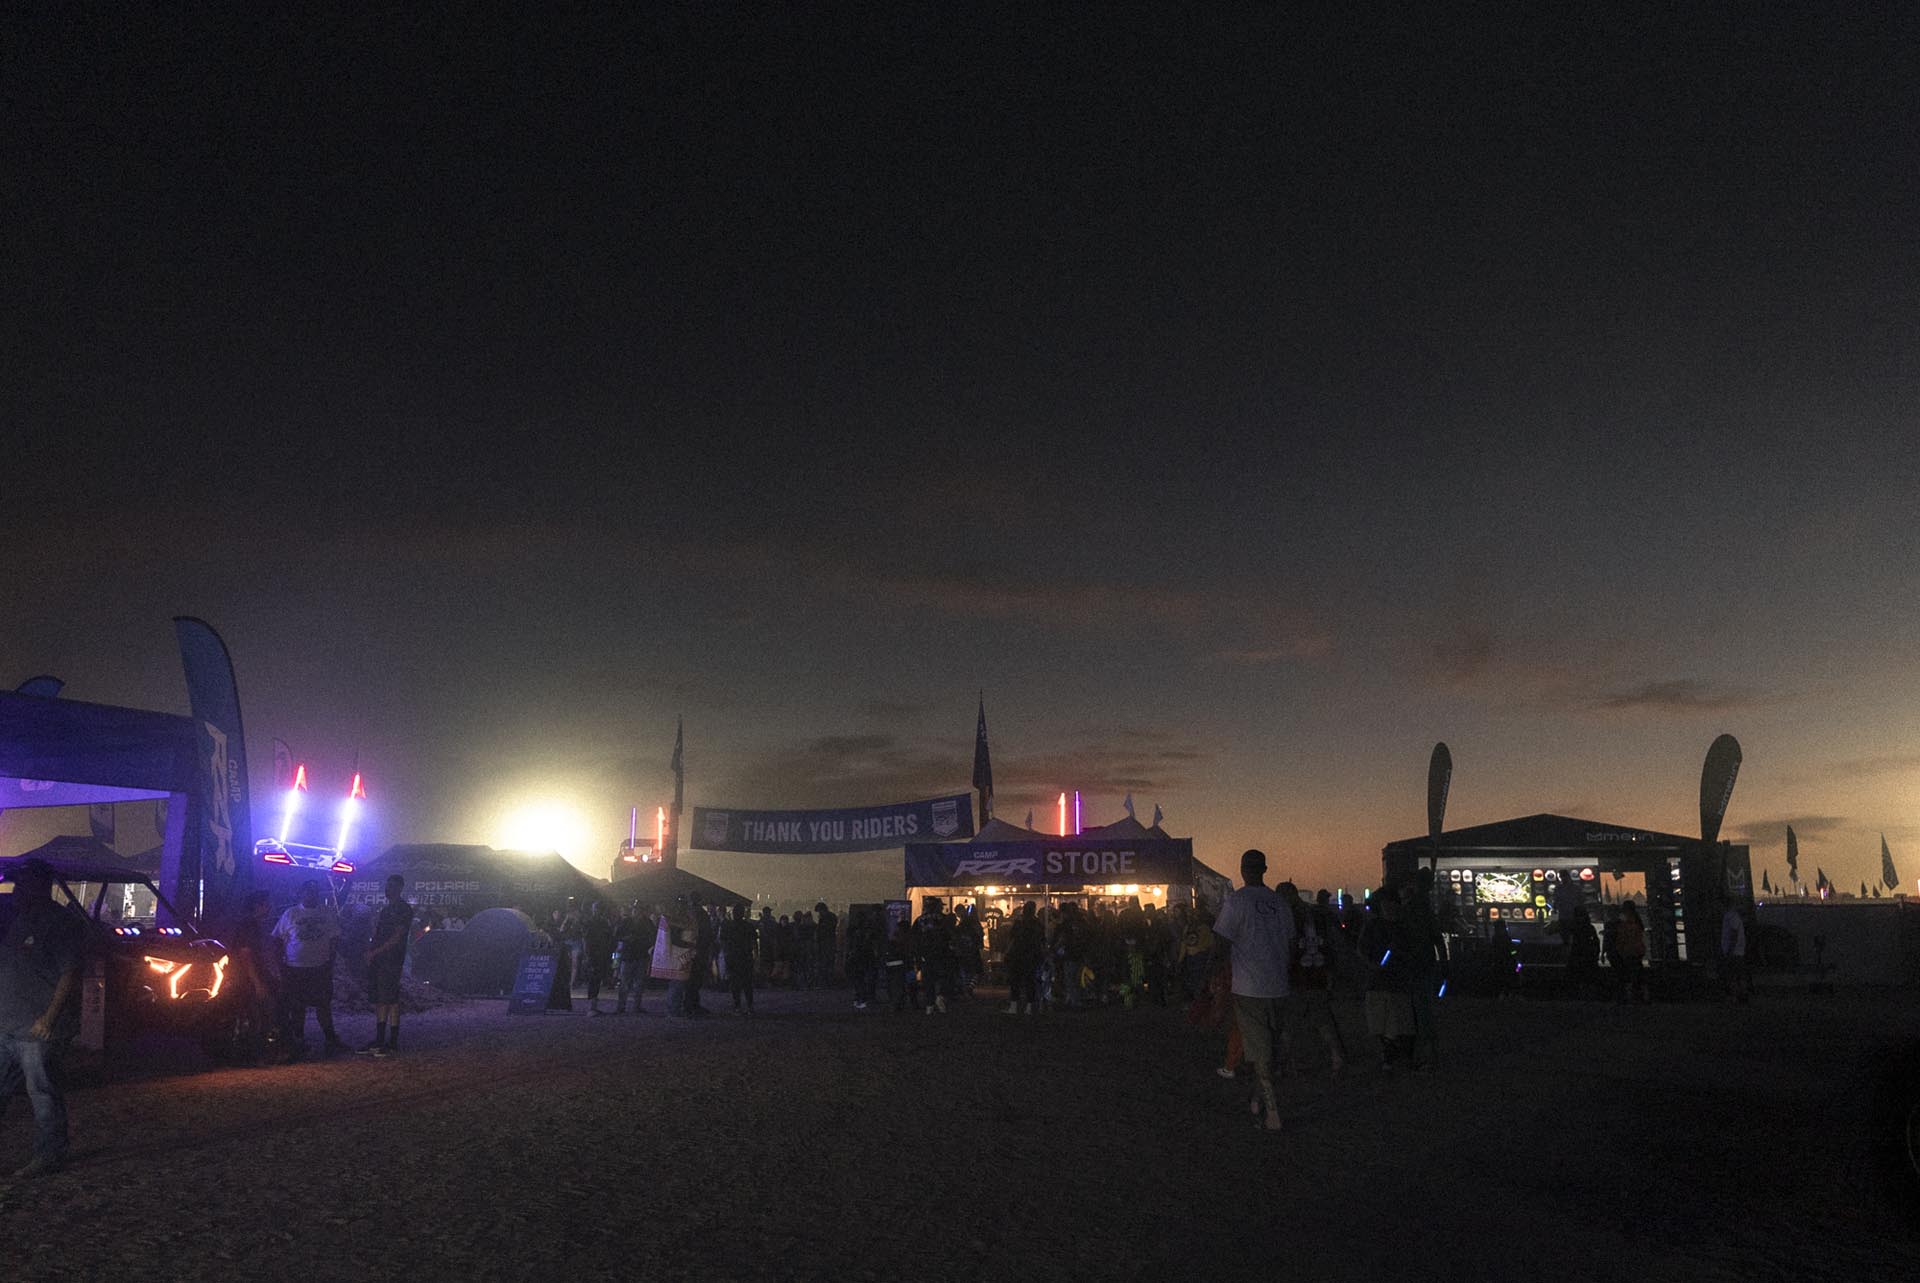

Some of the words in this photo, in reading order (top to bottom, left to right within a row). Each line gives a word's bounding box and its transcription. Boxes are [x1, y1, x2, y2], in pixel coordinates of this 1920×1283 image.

[229, 759, 242, 802] CAMP
[742, 820, 802, 842] THANK
[809, 820, 845, 842] YOU
[851, 814, 919, 840] RIDERS
[973, 851, 998, 859] CAMP
[1046, 851, 1137, 875] STORE
[953, 858, 1038, 878] RZR
[415, 881, 480, 891] POLARIS
[440, 894, 465, 905] ZONE
